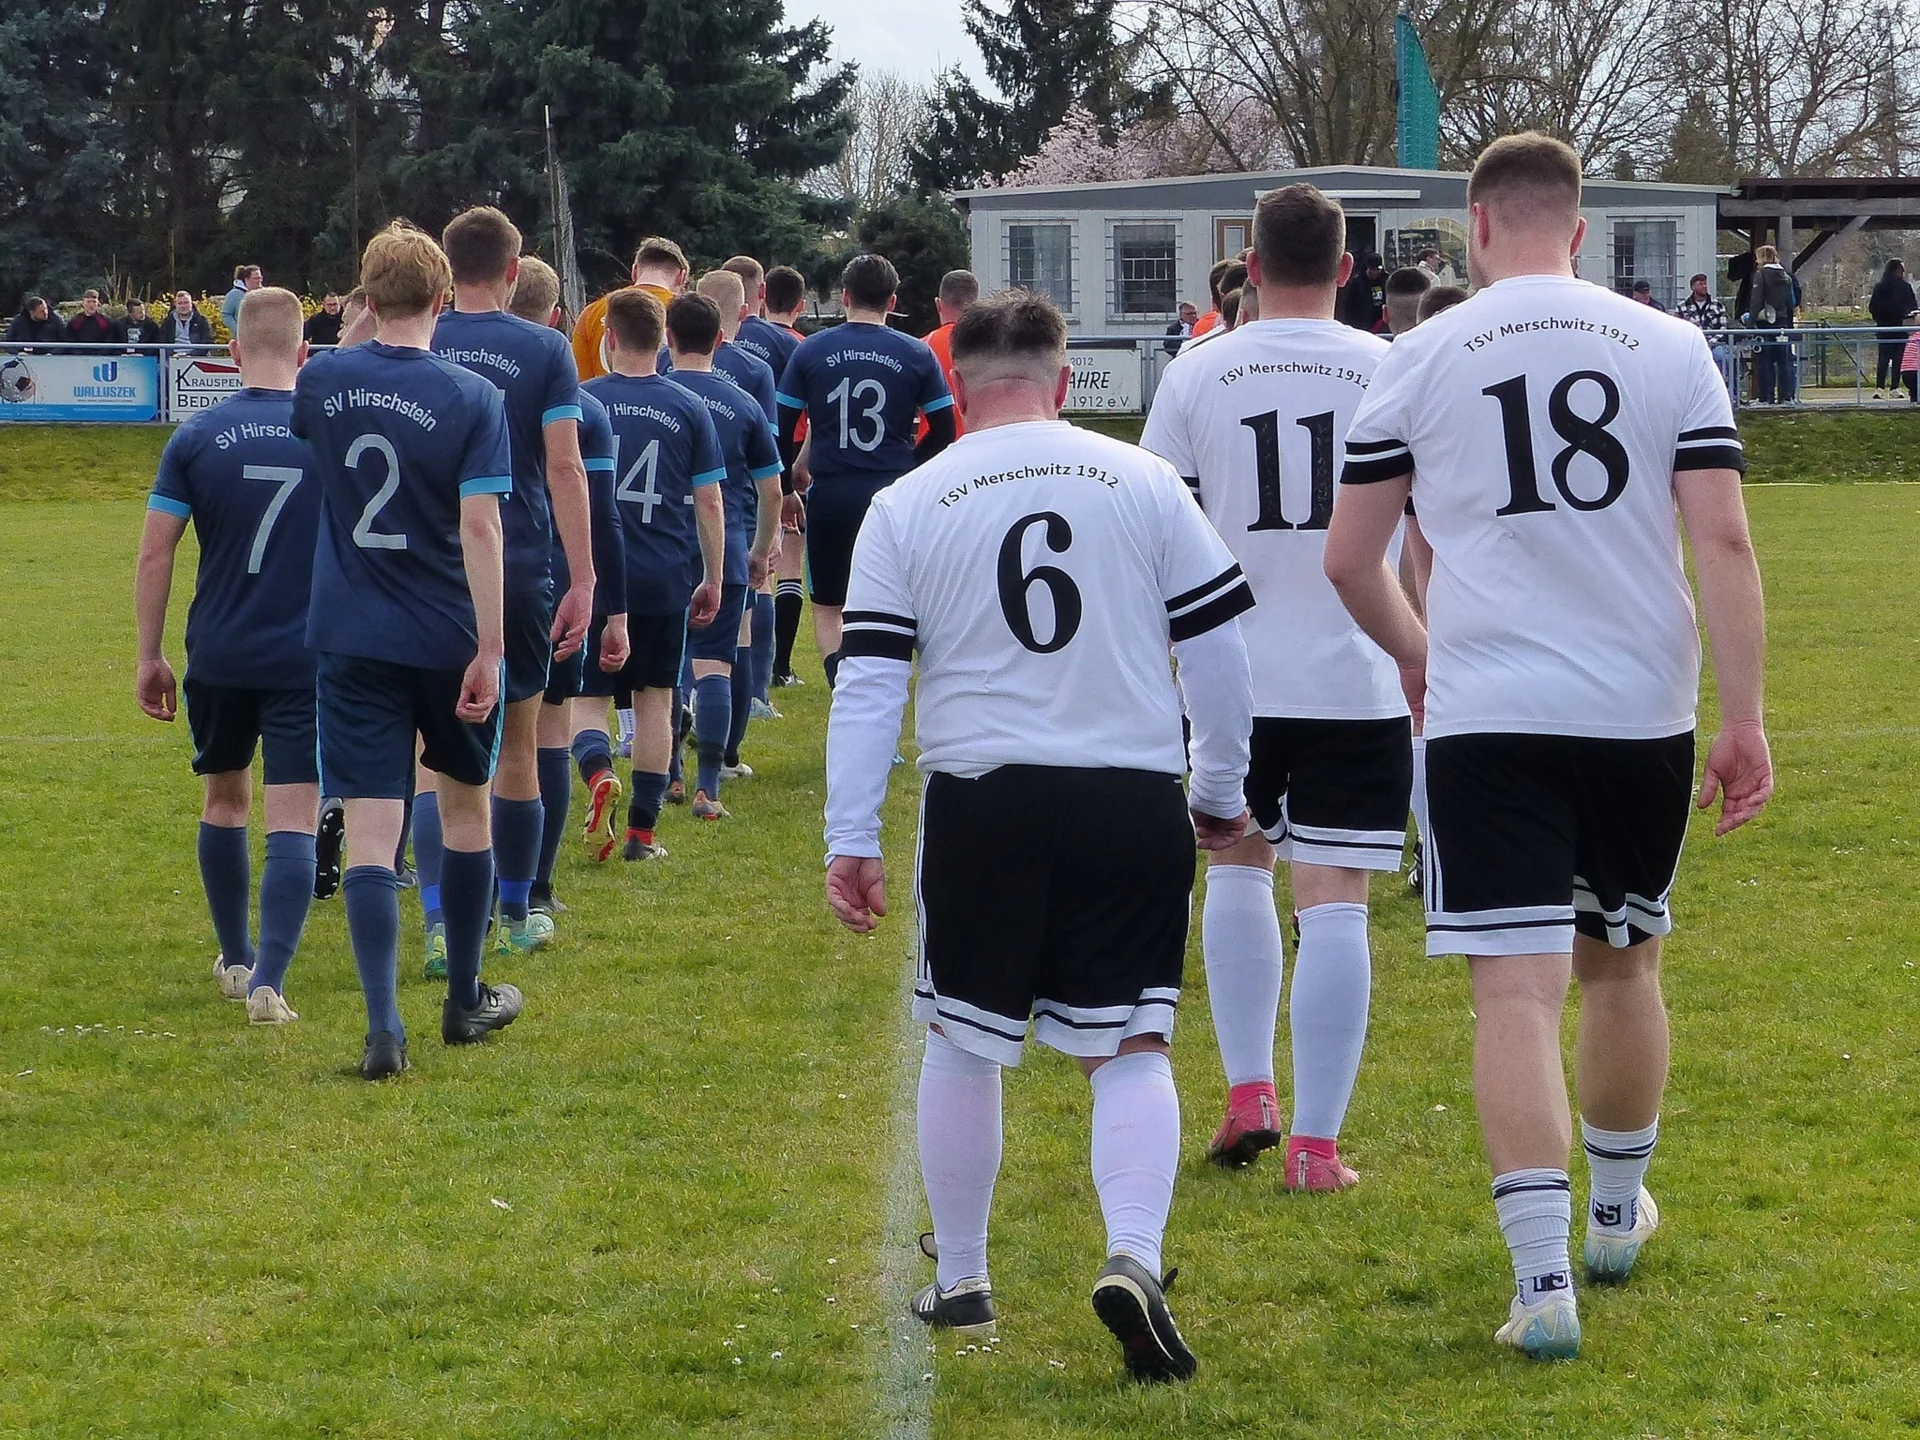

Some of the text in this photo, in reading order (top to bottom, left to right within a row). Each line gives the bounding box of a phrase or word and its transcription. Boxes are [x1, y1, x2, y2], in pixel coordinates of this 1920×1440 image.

[1463, 317, 1640, 352] TSV Merschwitz 1912
[440, 347, 520, 378] Hirschstein
[826, 349, 903, 373] SV Hirschstein
[1070, 357, 1094, 366] 2012
[1219, 362, 1371, 390] TSV Merschwitz 1912
[73, 386, 136, 398] WALLUSZEK
[1072, 396, 1103, 407] 1912
[324, 388, 437, 432] SV Hirschstein
[613, 403, 681, 433] Hirschstein
[827, 377, 886, 452] 13
[215, 427, 237, 449] SV
[1482, 370, 1630, 517] 18
[938, 463, 1119, 509] TSV Merschwitz 1912
[1240, 409, 1335, 532] 11
[345, 433, 407, 549] 2
[243, 464, 303, 573] 7
[997, 511, 1082, 654] 6
